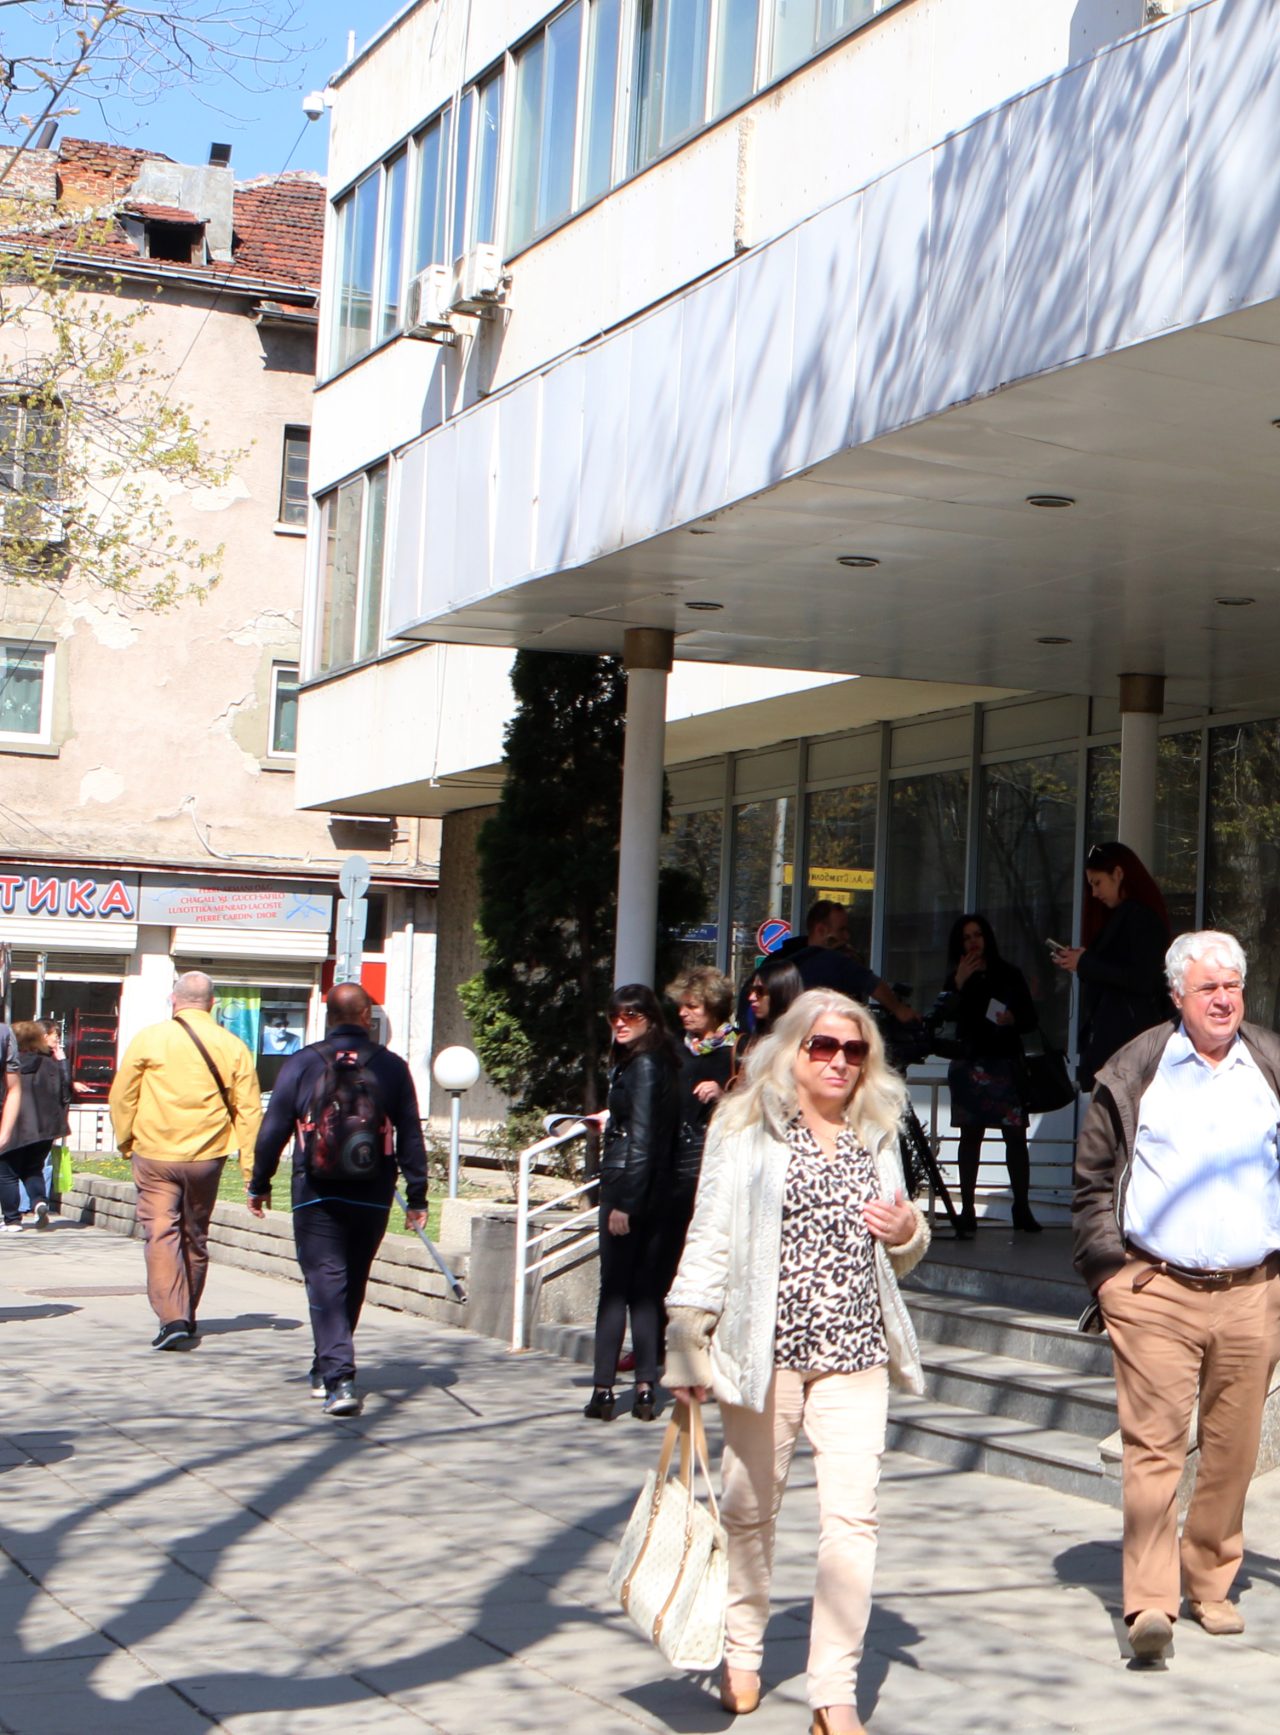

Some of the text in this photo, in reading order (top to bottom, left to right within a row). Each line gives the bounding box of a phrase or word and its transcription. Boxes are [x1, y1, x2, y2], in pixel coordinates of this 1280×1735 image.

[0, 874, 134, 917] ТИКА
[232, 894, 257, 902] GUCCI
[212, 904, 248, 912] MENRAD
[249, 902, 282, 910] LACOSTE
[196, 914, 221, 923] PIERRE
[257, 911, 277, 919] DIOR
